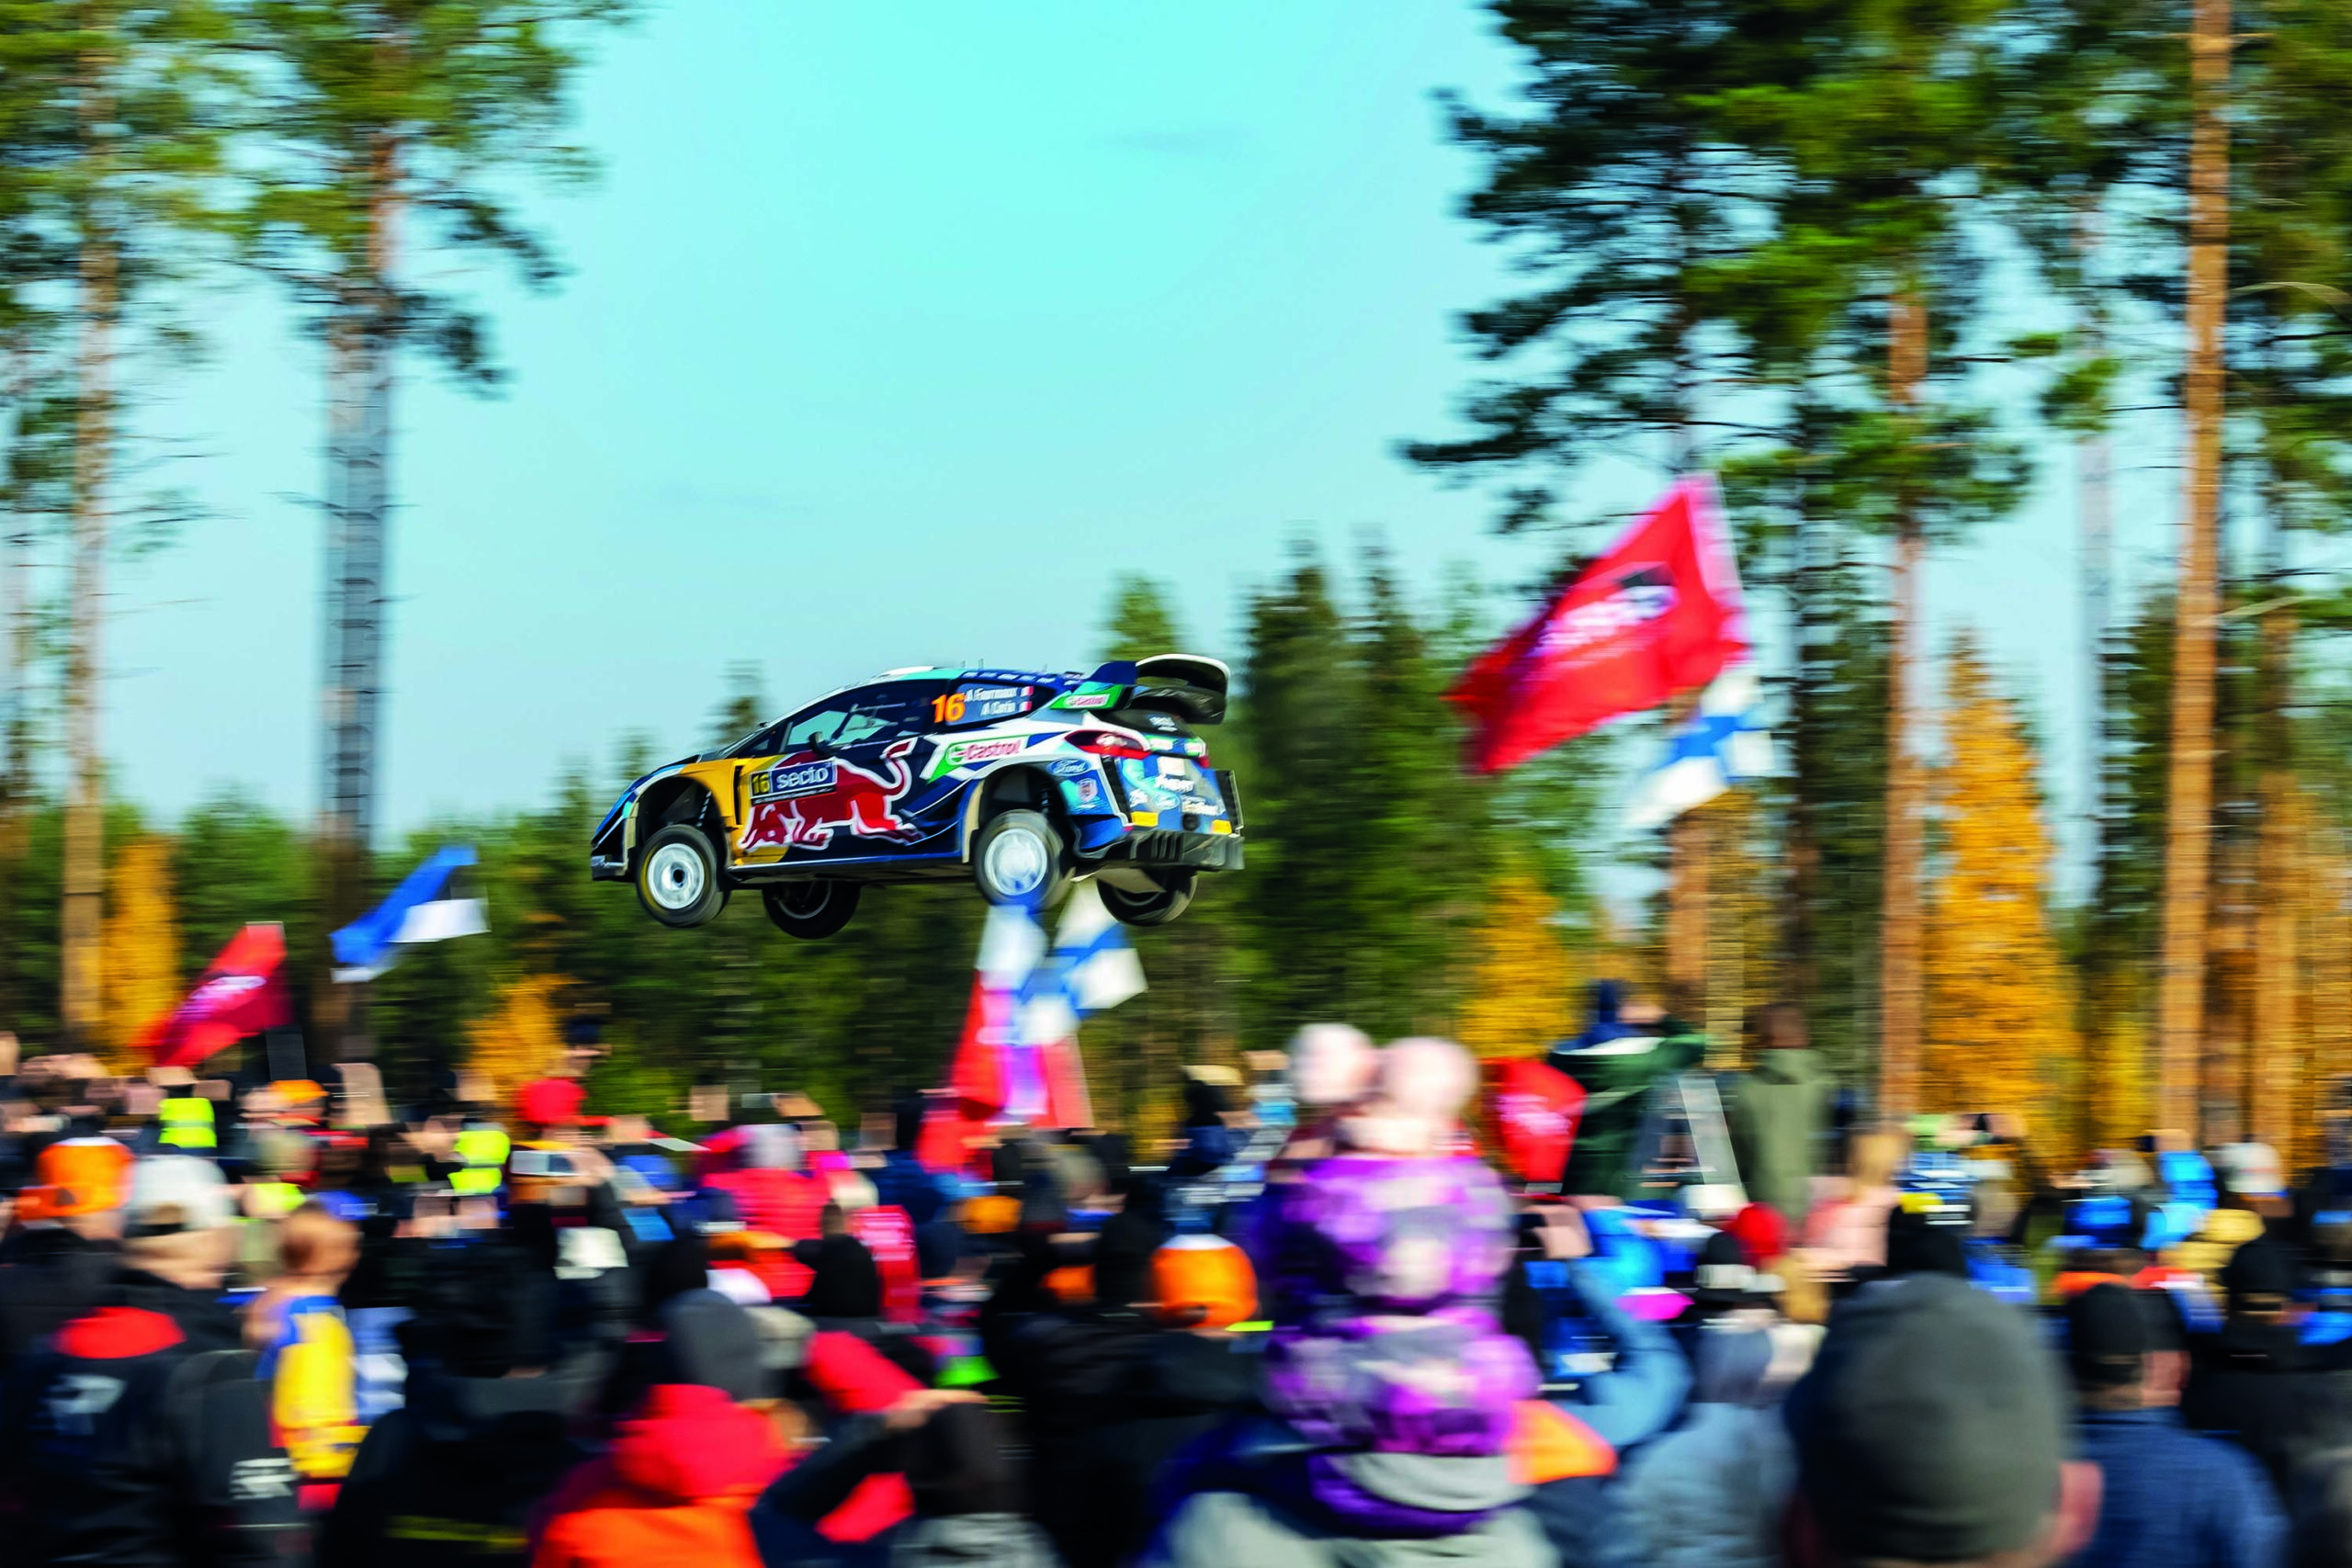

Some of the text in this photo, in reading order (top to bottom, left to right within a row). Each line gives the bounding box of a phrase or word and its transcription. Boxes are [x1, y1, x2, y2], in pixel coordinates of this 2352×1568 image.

[932, 693, 966, 723] 16
[966, 739, 1022, 761] Castrol
[1053, 760, 1087, 773] Ford
[752, 766, 829, 795] 16 secto
